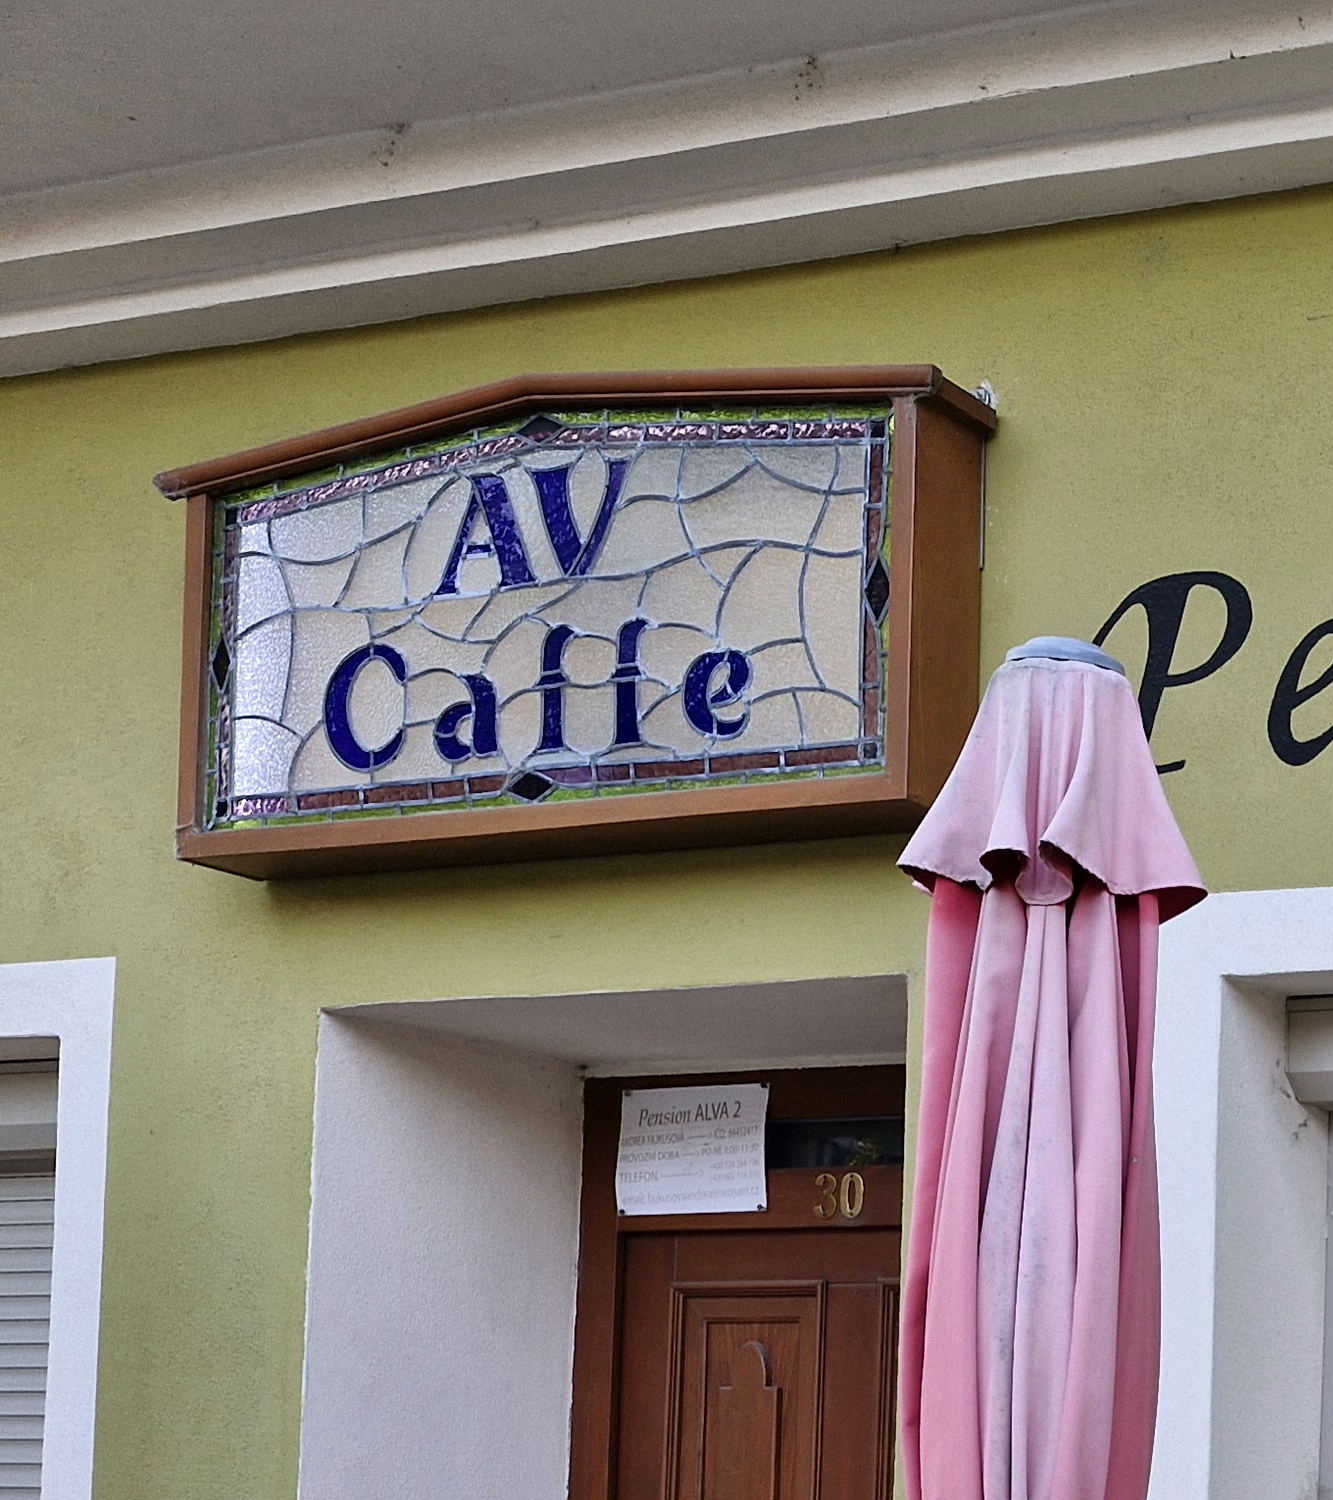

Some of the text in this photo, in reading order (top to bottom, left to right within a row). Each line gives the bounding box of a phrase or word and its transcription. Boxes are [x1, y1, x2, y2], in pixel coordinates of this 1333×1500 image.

[435, 459, 628, 597] AV
[323, 617, 755, 772] Caffe
[639, 1101, 741, 1127] Pension ALVA 2
[620, 1149, 656, 1163] PROVOZNÍ
[657, 1150, 680, 1161] DOBA
[620, 1170, 658, 1182] TELEFON
[813, 1171, 865, 1219] 30
